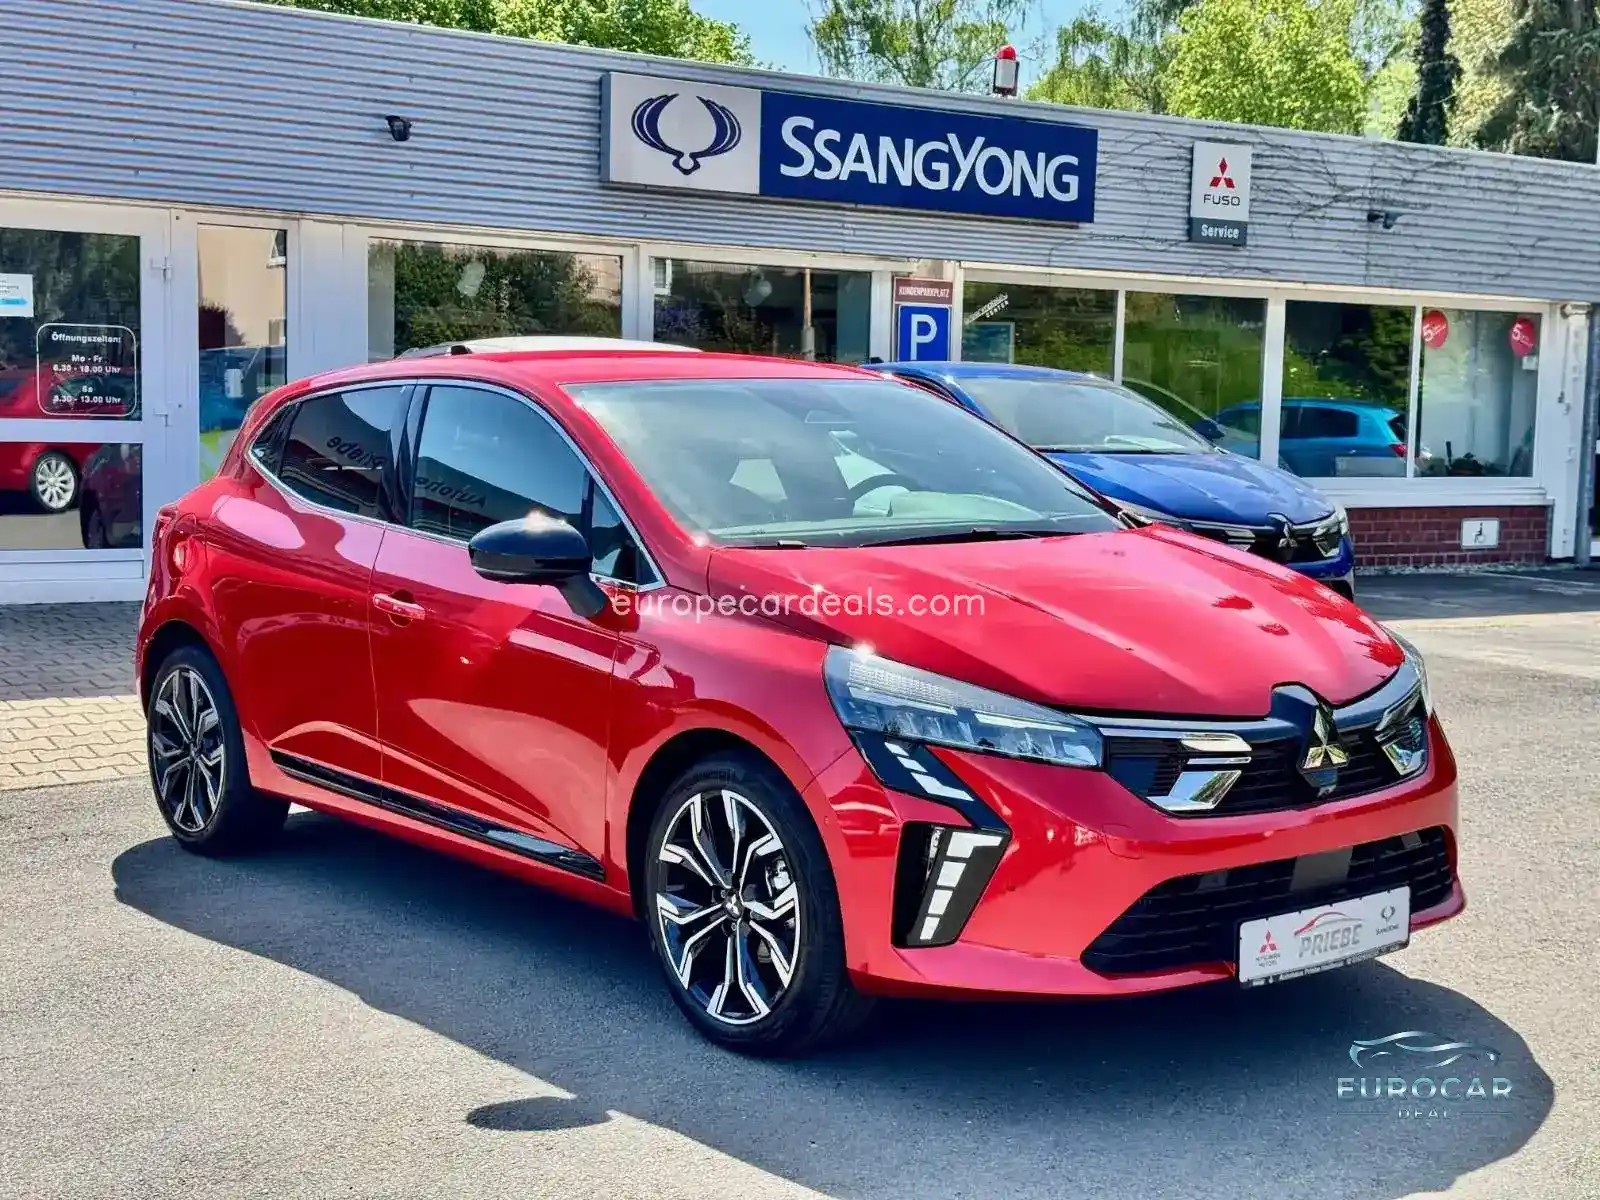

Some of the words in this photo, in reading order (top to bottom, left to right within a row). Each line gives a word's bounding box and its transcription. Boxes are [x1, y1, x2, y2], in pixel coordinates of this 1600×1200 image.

[780, 116, 1079, 202] SSANGYONG
[1203, 194, 1240, 206] FUSO
[1201, 224, 1240, 238] Service
[898, 286, 950, 298] KUNDENPARKPLATZ
[51, 332, 121, 343] Öffnungszeiten:
[910, 314, 938, 361] P
[1422, 323, 1434, 341] 5
[71, 354, 86, 362] Mo
[105, 366, 121, 374] Uhr
[105, 395, 121, 403] Uhr
[1298, 924, 1363, 958] PRIEBE
